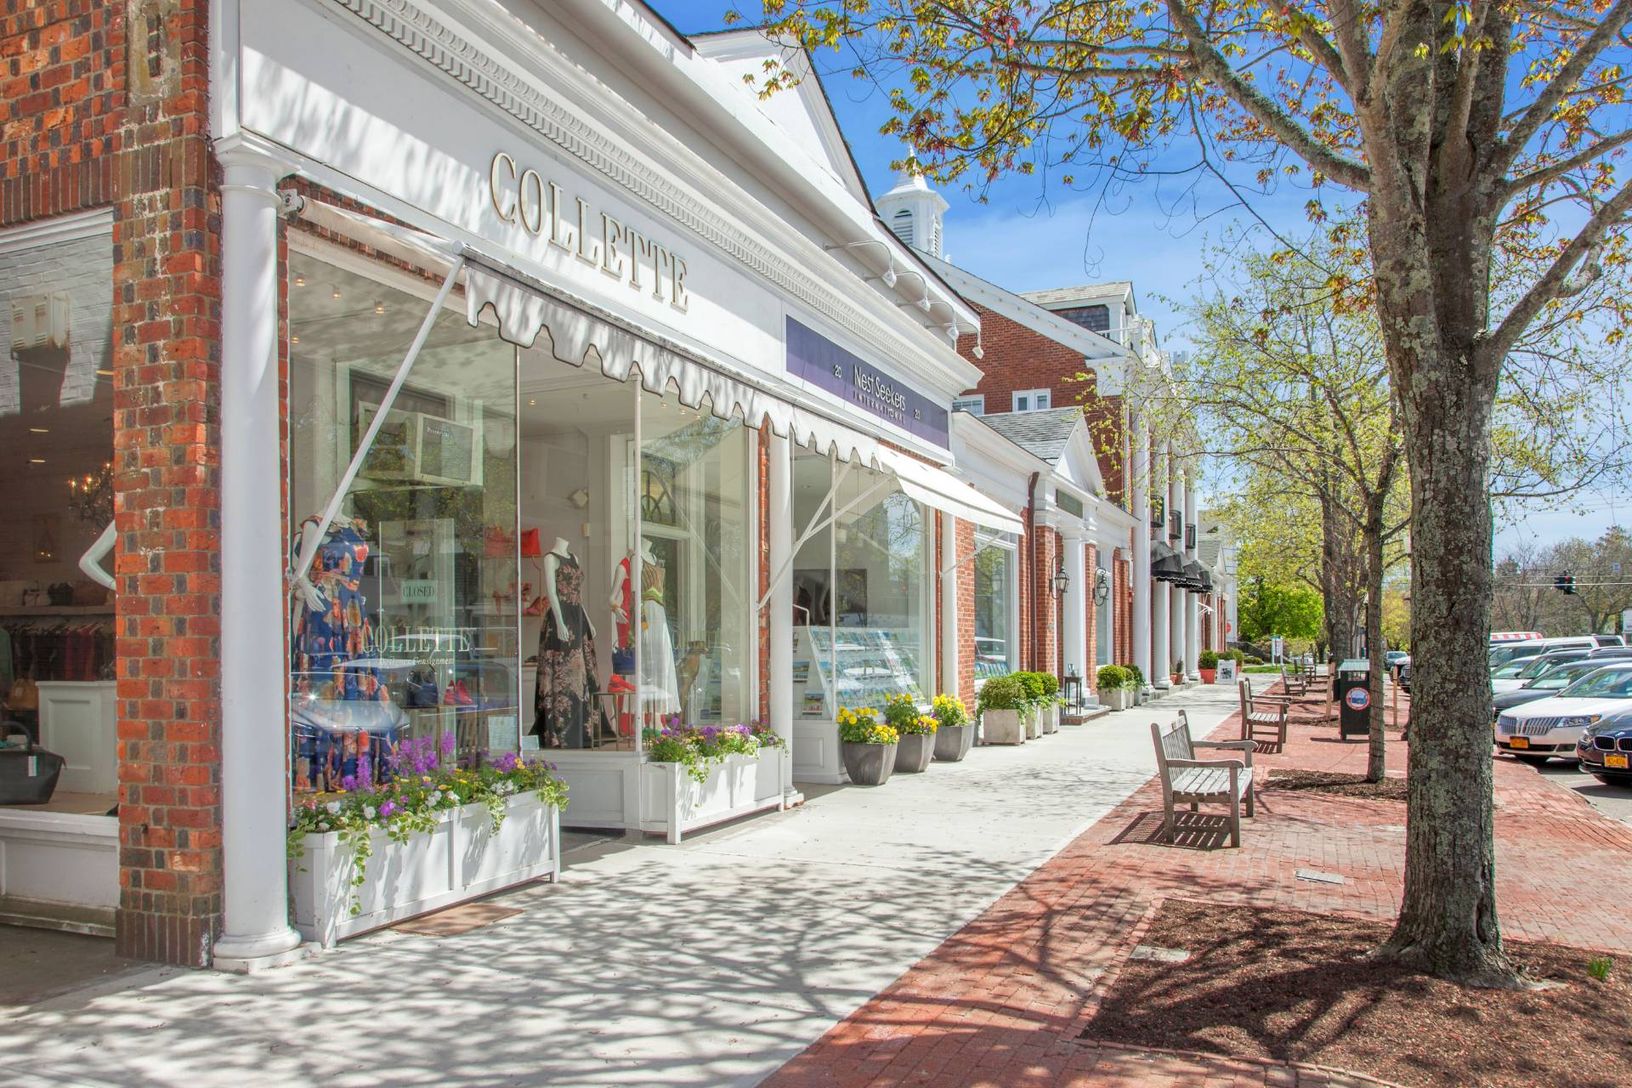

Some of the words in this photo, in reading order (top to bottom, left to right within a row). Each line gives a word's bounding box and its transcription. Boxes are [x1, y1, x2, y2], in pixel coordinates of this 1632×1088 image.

[489, 152, 689, 315] COLLETTE
[832, 364, 843, 379] 20
[853, 364, 874, 395] Nest
[875, 376, 906, 412] Seekers
[853, 390, 905, 425] INTERNATIONAL
[402, 586, 435, 598] CLOSED
[360, 625, 471, 654] COLLETTE
